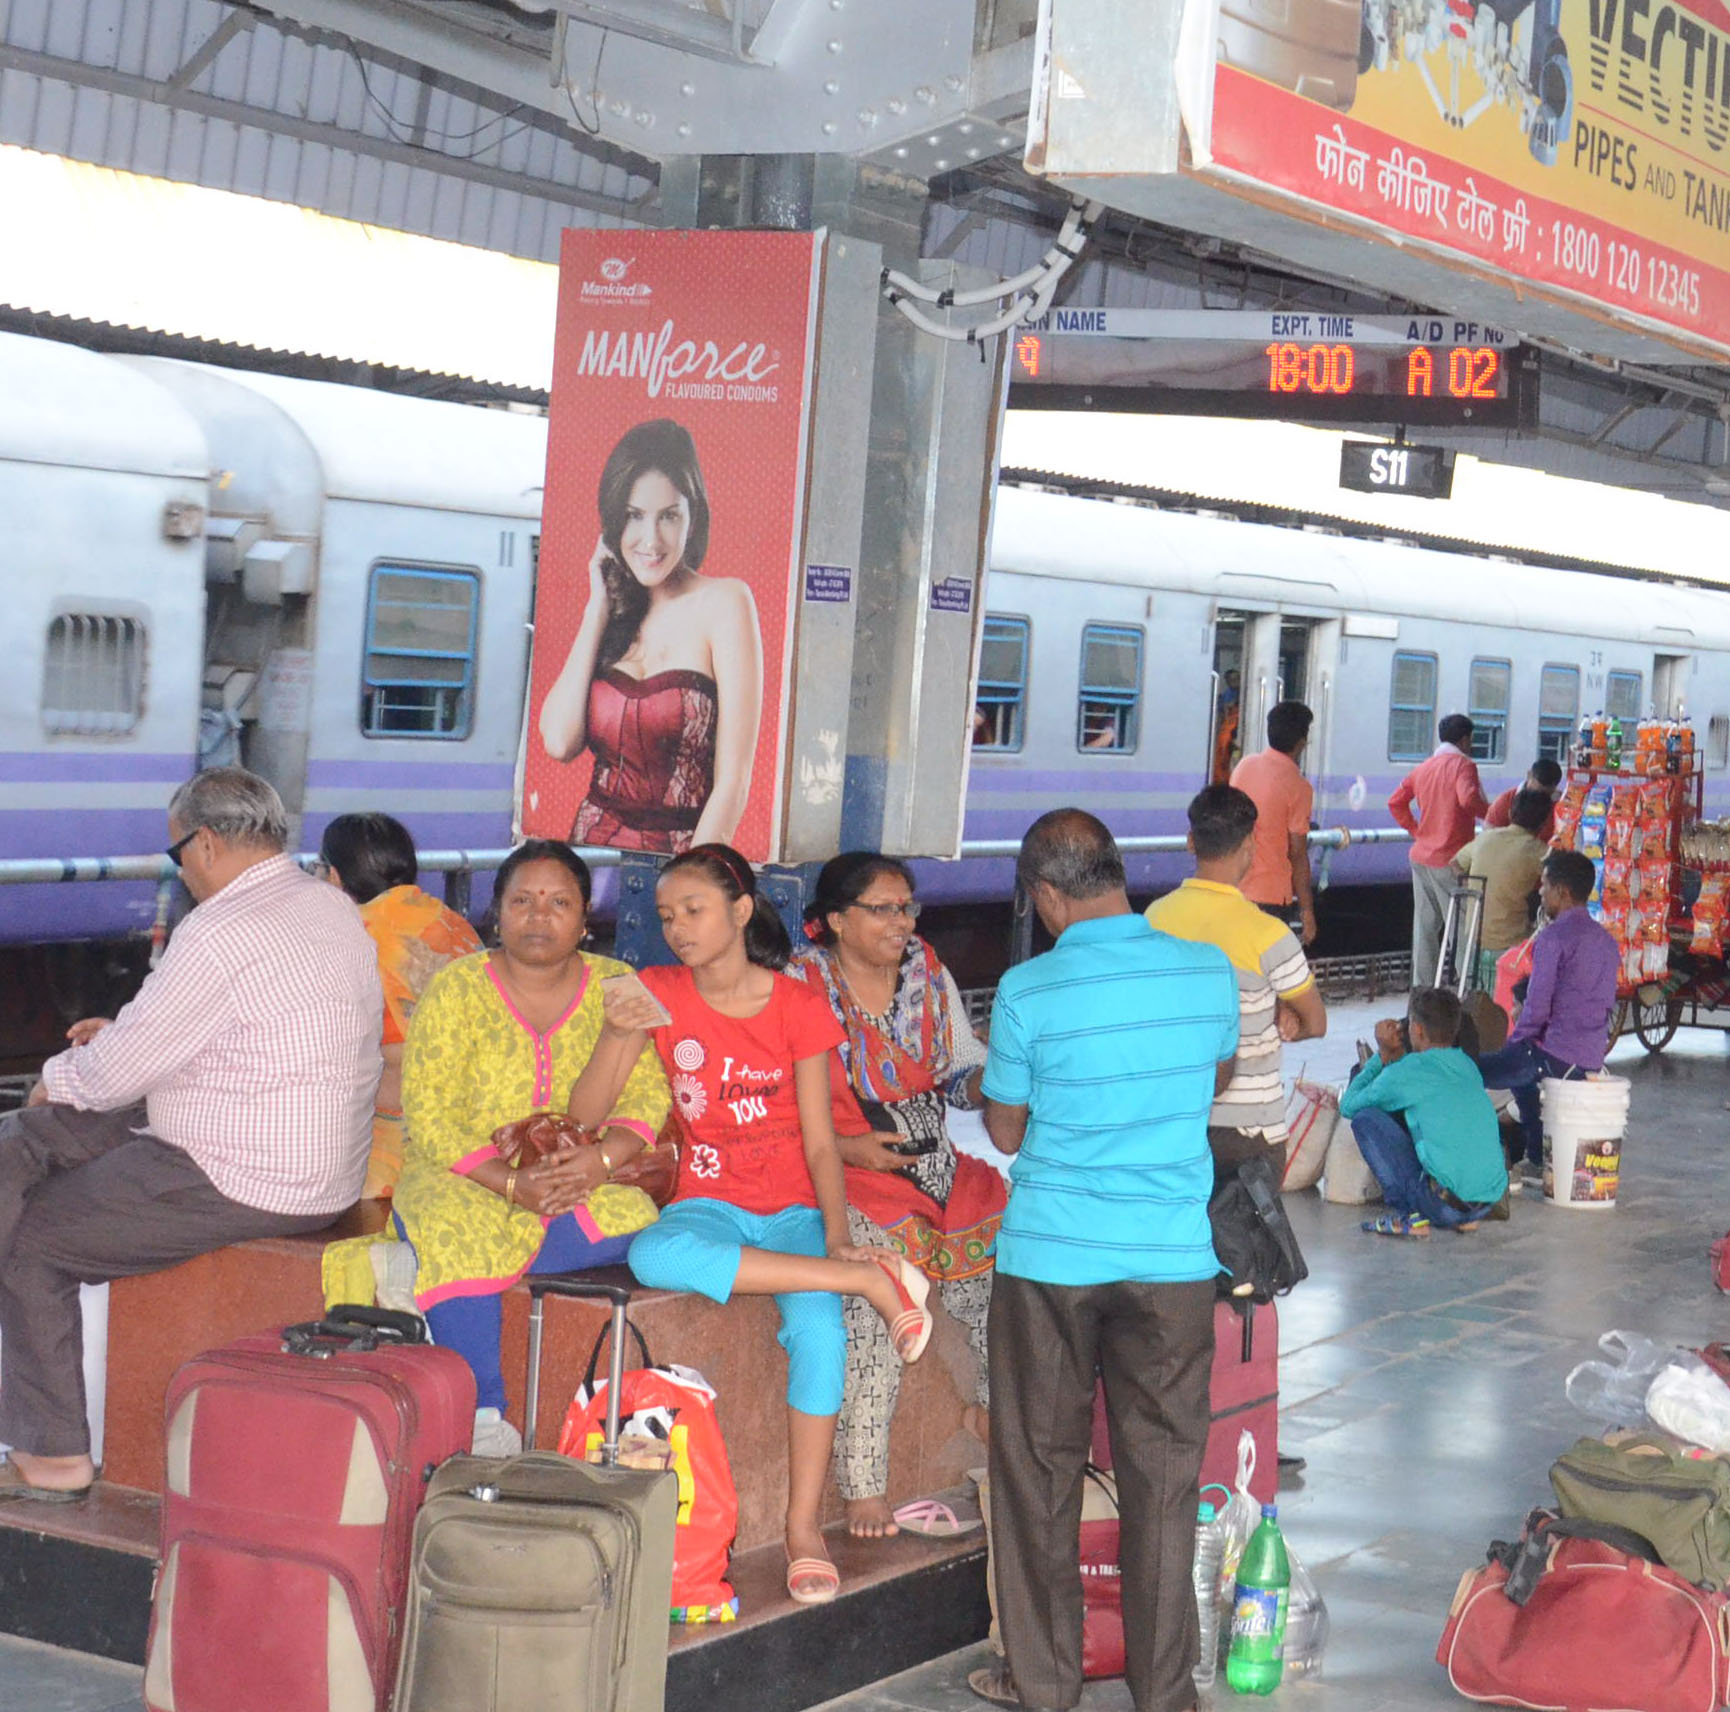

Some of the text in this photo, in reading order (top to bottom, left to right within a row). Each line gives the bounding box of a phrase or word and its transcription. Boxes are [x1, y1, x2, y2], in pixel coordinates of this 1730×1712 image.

[1574, 119, 1638, 191] PIPES
[1644, 163, 1676, 200] AND
[1315, 123, 1371, 193] फोन
[1376, 146, 1452, 230] कीजिए
[1456, 176, 1498, 242] टोल
[1502, 198, 1532, 254] फ्री
[1552, 219, 1600, 278] 1800
[1607, 240, 1640, 294] 120
[1648, 257, 1701, 315] 12345
[581, 281, 638, 297] Mankind
[1056, 311, 1107, 332] NAME
[1272, 315, 1354, 338] EXPT. TIME
[1407, 320, 1444, 343] A/D
[1453, 322, 1479, 343] PF
[1265, 342, 1354, 394] 18:00
[1407, 345, 1433, 397] A
[1449, 346, 1498, 399] 02
[665, 382, 779, 403] FLAVOURED CONDOMS
[1368, 447, 1408, 486] S11
[721, 1057, 784, 1081] I have
[727, 1095, 768, 1125] YOU
